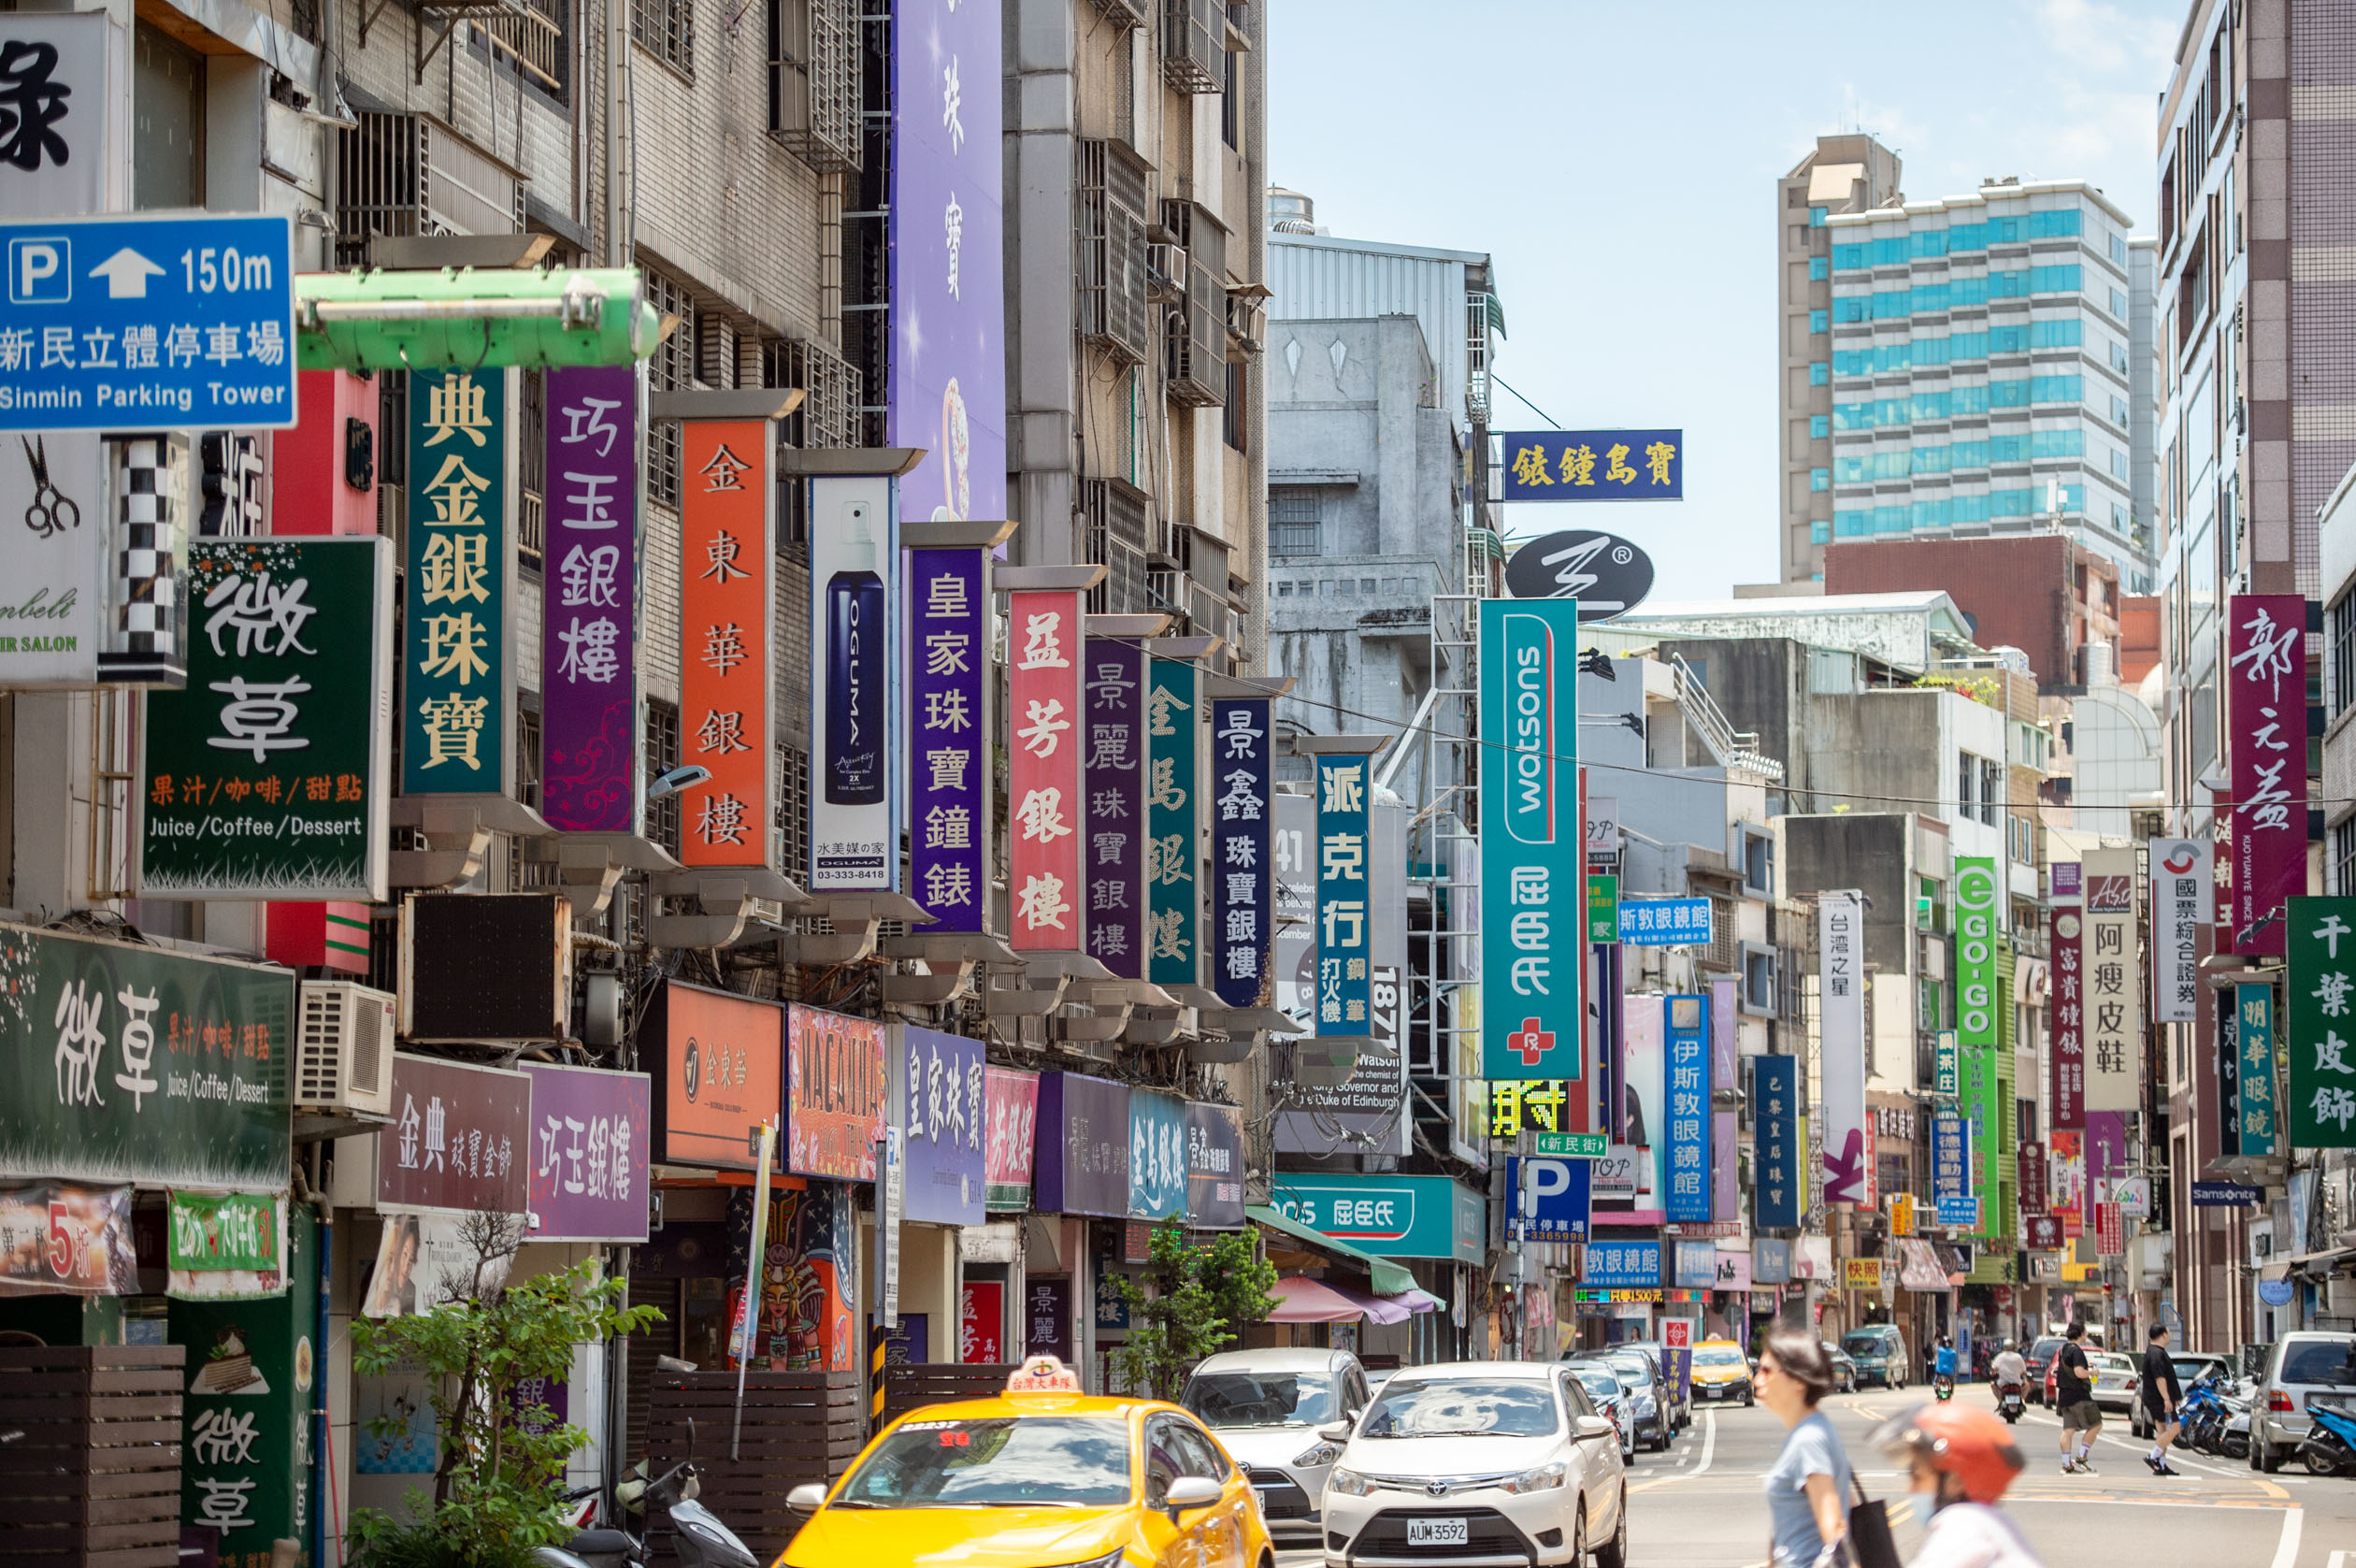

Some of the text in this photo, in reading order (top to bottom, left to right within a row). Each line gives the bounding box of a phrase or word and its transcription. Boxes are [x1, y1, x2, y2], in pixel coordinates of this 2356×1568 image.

[943, 0, 965, 302] 珠寶
[181, 247, 272, 294] 150m
[0, 321, 284, 371] 新民立體停車場
[0, 382, 285, 411] Sinmin Parking Tower
[557, 396, 622, 684] 巧玉銀樓
[0, 587, 77, 621] nbelt
[0, 636, 77, 652] IR SALON
[204, 571, 318, 764] 微草
[695, 444, 753, 847] 金東華銀樓
[850, 599, 859, 745] OGUMA
[925, 573, 970, 909] 皇家珠寶鐘錶
[1517, 646, 1541, 814] watsons
[2233, 608, 2298, 831] 郭元益
[151, 772, 363, 805] 果汁/咖啡/甜點
[1016, 611, 1072, 931] 益芳銀樓
[1085, 664, 1137, 957] 景麗珠寶銀樓
[150, 814, 362, 840] Juice/Coffee/Dessert
[1151, 684, 1192, 962] 金馬銀樓
[1217, 710, 1263, 980] 景鑫珠寶銀樓
[1322, 762, 1364, 948] 派克行
[2243, 835, 2251, 854] KUO
[818, 870, 884, 880] 03-333-8418
[2243, 855, 2251, 877] YUAN
[2243, 879, 2251, 891] YE
[1510, 866, 1550, 996] 屈臣氏
[1620, 905, 1708, 931] 斯敦眼鏡館
[2176, 879, 2196, 1004] 國票綜合證券
[1321, 957, 1342, 1024] 打火機
[1346, 957, 1366, 1023] 鋼筆
[2059, 946, 2083, 1055] 富貴鐘錶
[2095, 922, 2126, 1073] 阿瘦皮鞋
[2309, 913, 2356, 1132] 千葉皮飾
[54, 978, 160, 1114] 微草
[704, 1043, 748, 1092] 金東華
[2244, 1000, 2272, 1138] 明華眼鏡
[908, 1043, 981, 1151] 皇家珠寶
[1341, 1095, 1351, 1105] of
[1353, 1095, 1400, 1110] Edinburgh
[1381, 1083, 1399, 1092] and
[1673, 1041, 1701, 1195] 伊斯敦眼鏡館
[539, 1115, 631, 1201] 巧玉銀樓
[985, 1097, 1033, 1178] 芳銀樓
[1133, 1115, 1185, 1193] 金馬銀樓
[1547, 1137, 1597, 1153] 新民街
[969, 1180, 982, 1204] GIA
[1334, 1200, 1394, 1226] 屈臣氏
[1526, 1160, 1571, 1218] P
[1507, 1230, 1585, 1243] 0-3365998
[1847, 1262, 1879, 1279] 快照
[1030, 1287, 1058, 1356] 景麗
[191, 1406, 260, 1536] 微草
